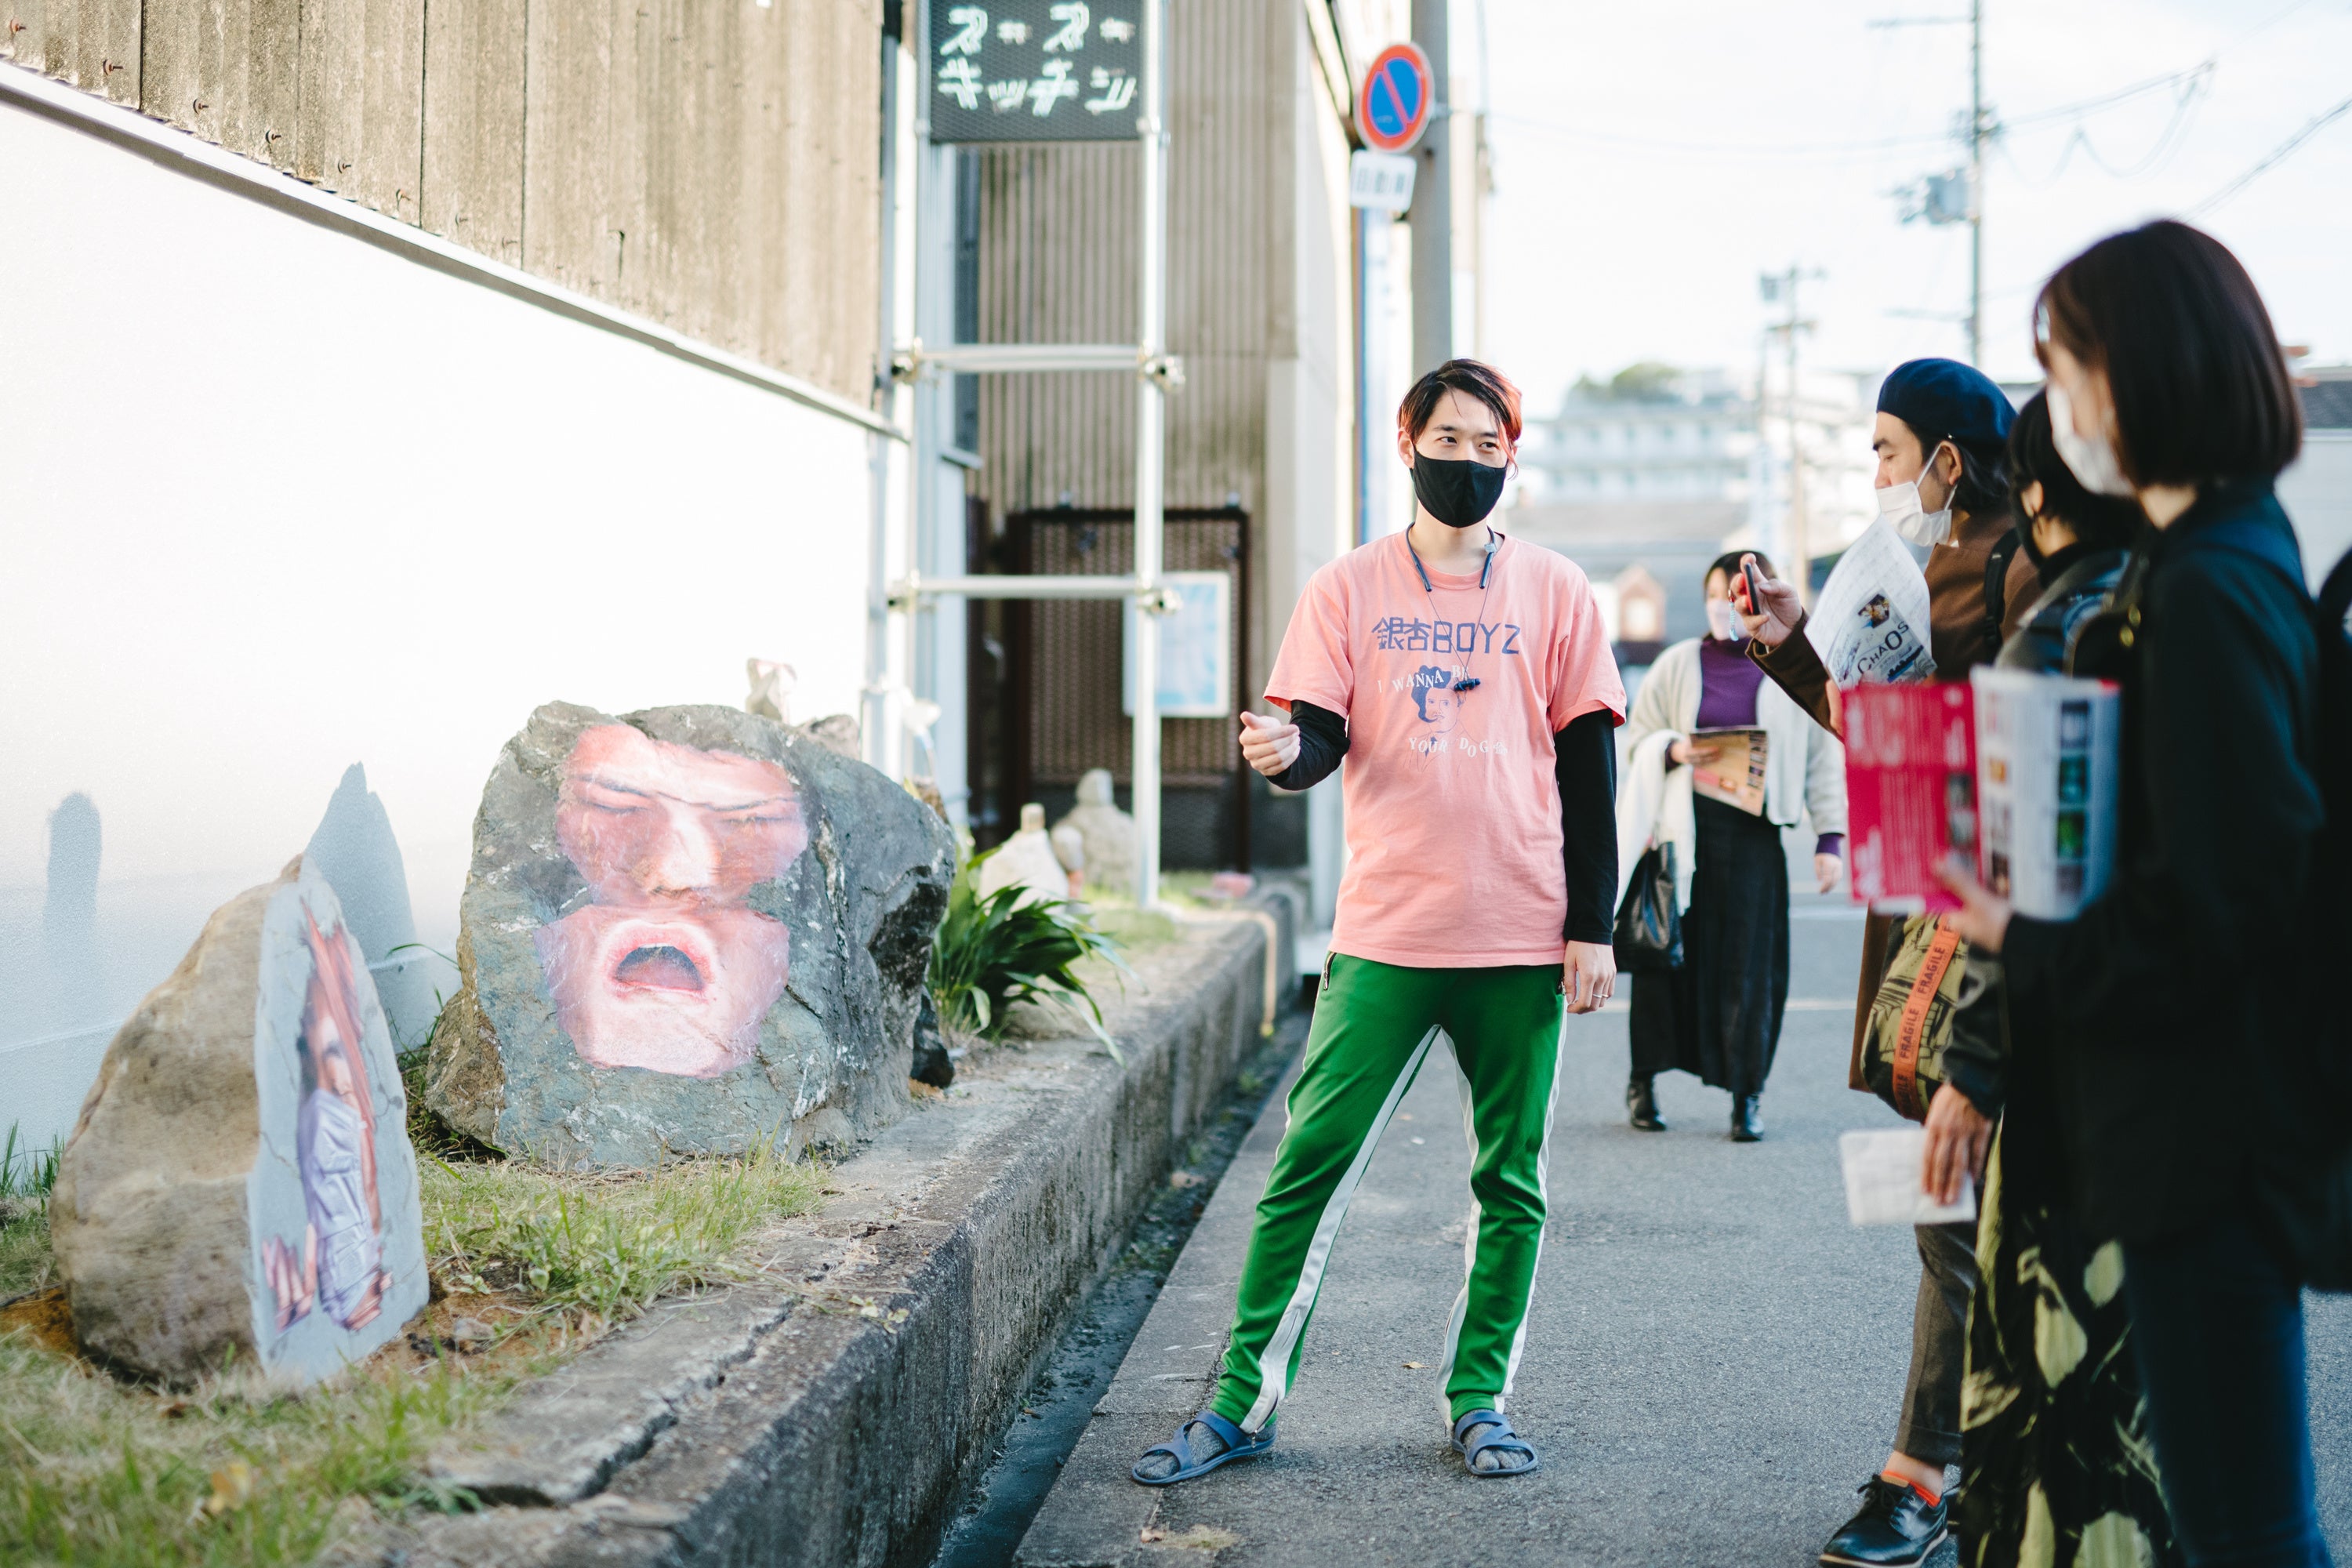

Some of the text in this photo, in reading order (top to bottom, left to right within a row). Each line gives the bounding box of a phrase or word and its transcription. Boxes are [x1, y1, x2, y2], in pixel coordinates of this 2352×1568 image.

[940, 2, 1136, 56] スースー
[938, 57, 1137, 116] キッチン
[1377, 680, 1383, 693] I
[1392, 670, 1444, 692] WANNA
[1408, 737, 1447, 753] YOUR
[1916, 946, 1945, 994] FRAGILE
[1900, 1007, 1920, 1059] FRAGILE
